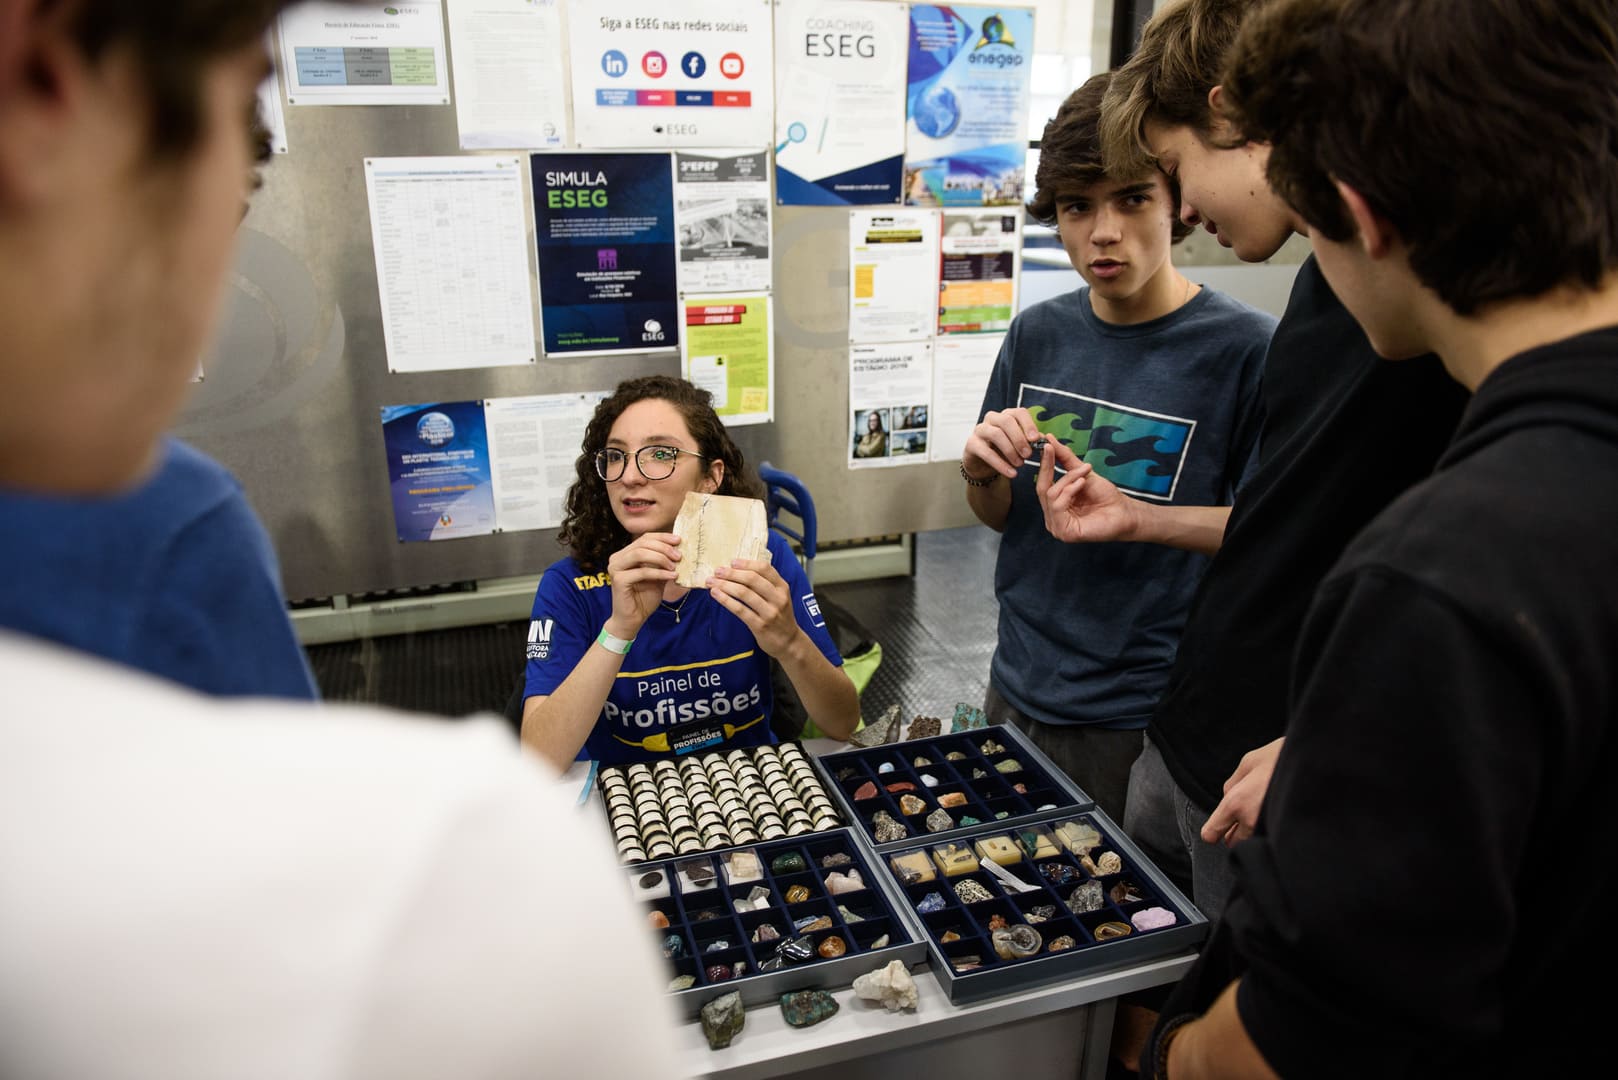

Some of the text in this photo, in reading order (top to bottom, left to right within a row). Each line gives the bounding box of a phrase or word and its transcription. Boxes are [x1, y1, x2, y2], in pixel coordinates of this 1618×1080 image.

[600, 16, 748, 33] Siga a ESEG nas redes sociais
[805, 18, 874, 32] COACHING
[806, 33, 875, 58] ESEG
[666, 124, 698, 136] ESEG
[545, 170, 608, 186] SIMULA
[548, 189, 608, 208] ESEG
[642, 332, 664, 341] ESEG
[637, 670, 721, 698] Painel de
[603, 684, 761, 728] Profissões
[673, 731, 722, 750] PROFISSÕES
